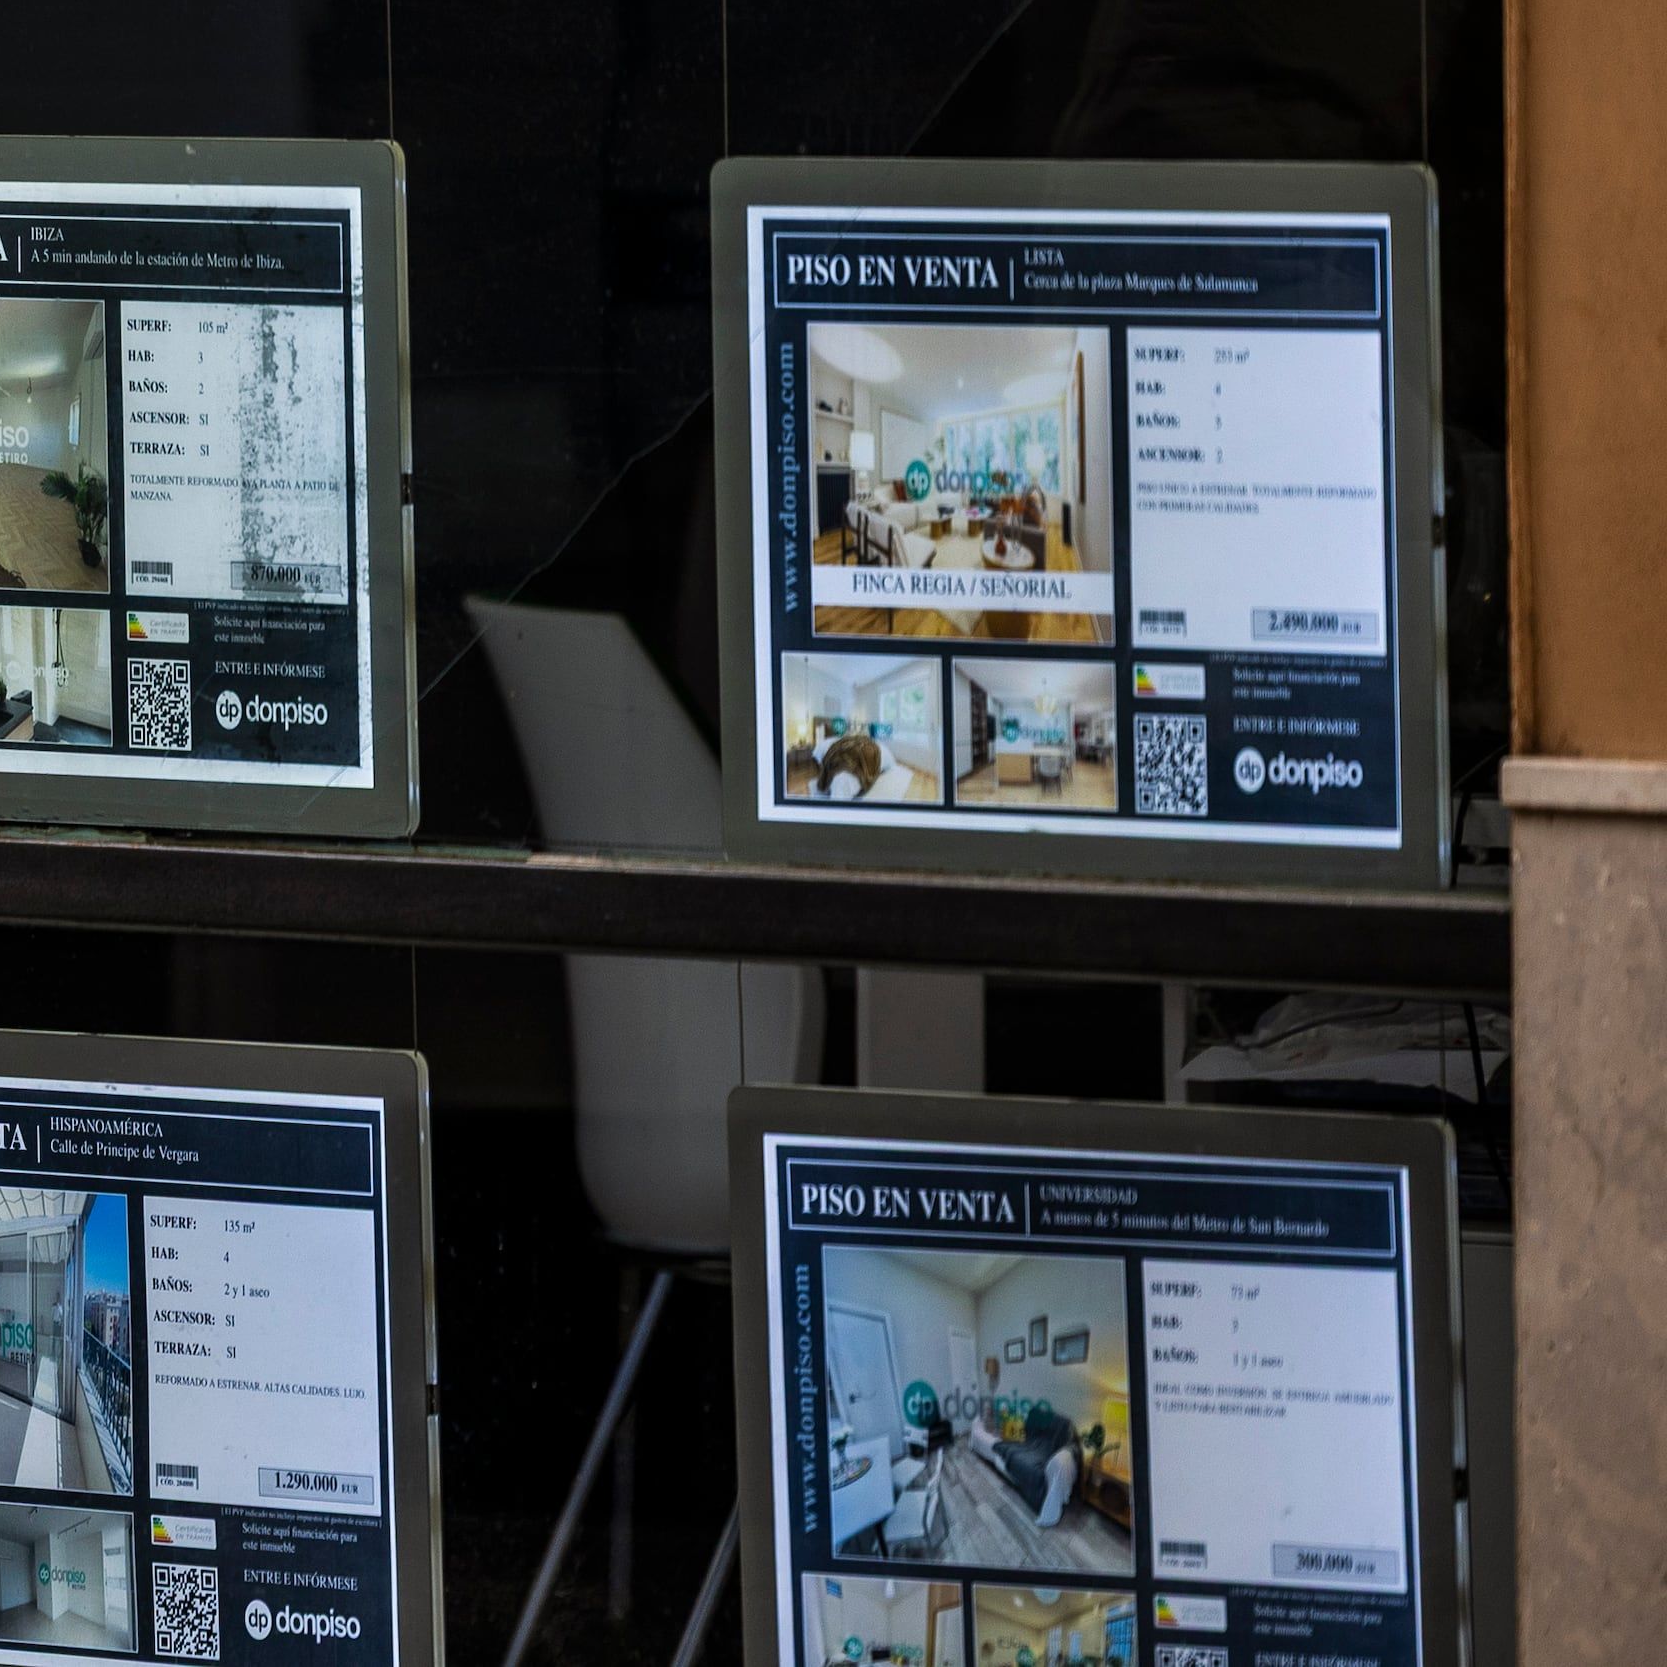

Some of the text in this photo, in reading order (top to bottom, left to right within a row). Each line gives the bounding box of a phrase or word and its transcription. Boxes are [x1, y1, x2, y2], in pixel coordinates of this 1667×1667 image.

[30, 226, 64, 241] IBIZA
[30, 248, 285, 270] A 5 min andando de la estación de Metro de Ibiza.
[1024, 247, 1065, 267] LISTA
[787, 254, 999, 288] PISO EN VENTA
[248, 563, 302, 588] 870.000
[852, 572, 1073, 600] FINCA REGIA SEÑORIAL
[245, 694, 328, 732] donpiso
[50, 1116, 164, 1138] HISPANOAMÉRICA
[50, 1138, 200, 1166] Calle de Principe de Vergara
[801, 1183, 1015, 1223] PISO EN VENTA
[275, 1472, 358, 1494] 1.290.000 EUR
[275, 1604, 361, 1644] donpiso
